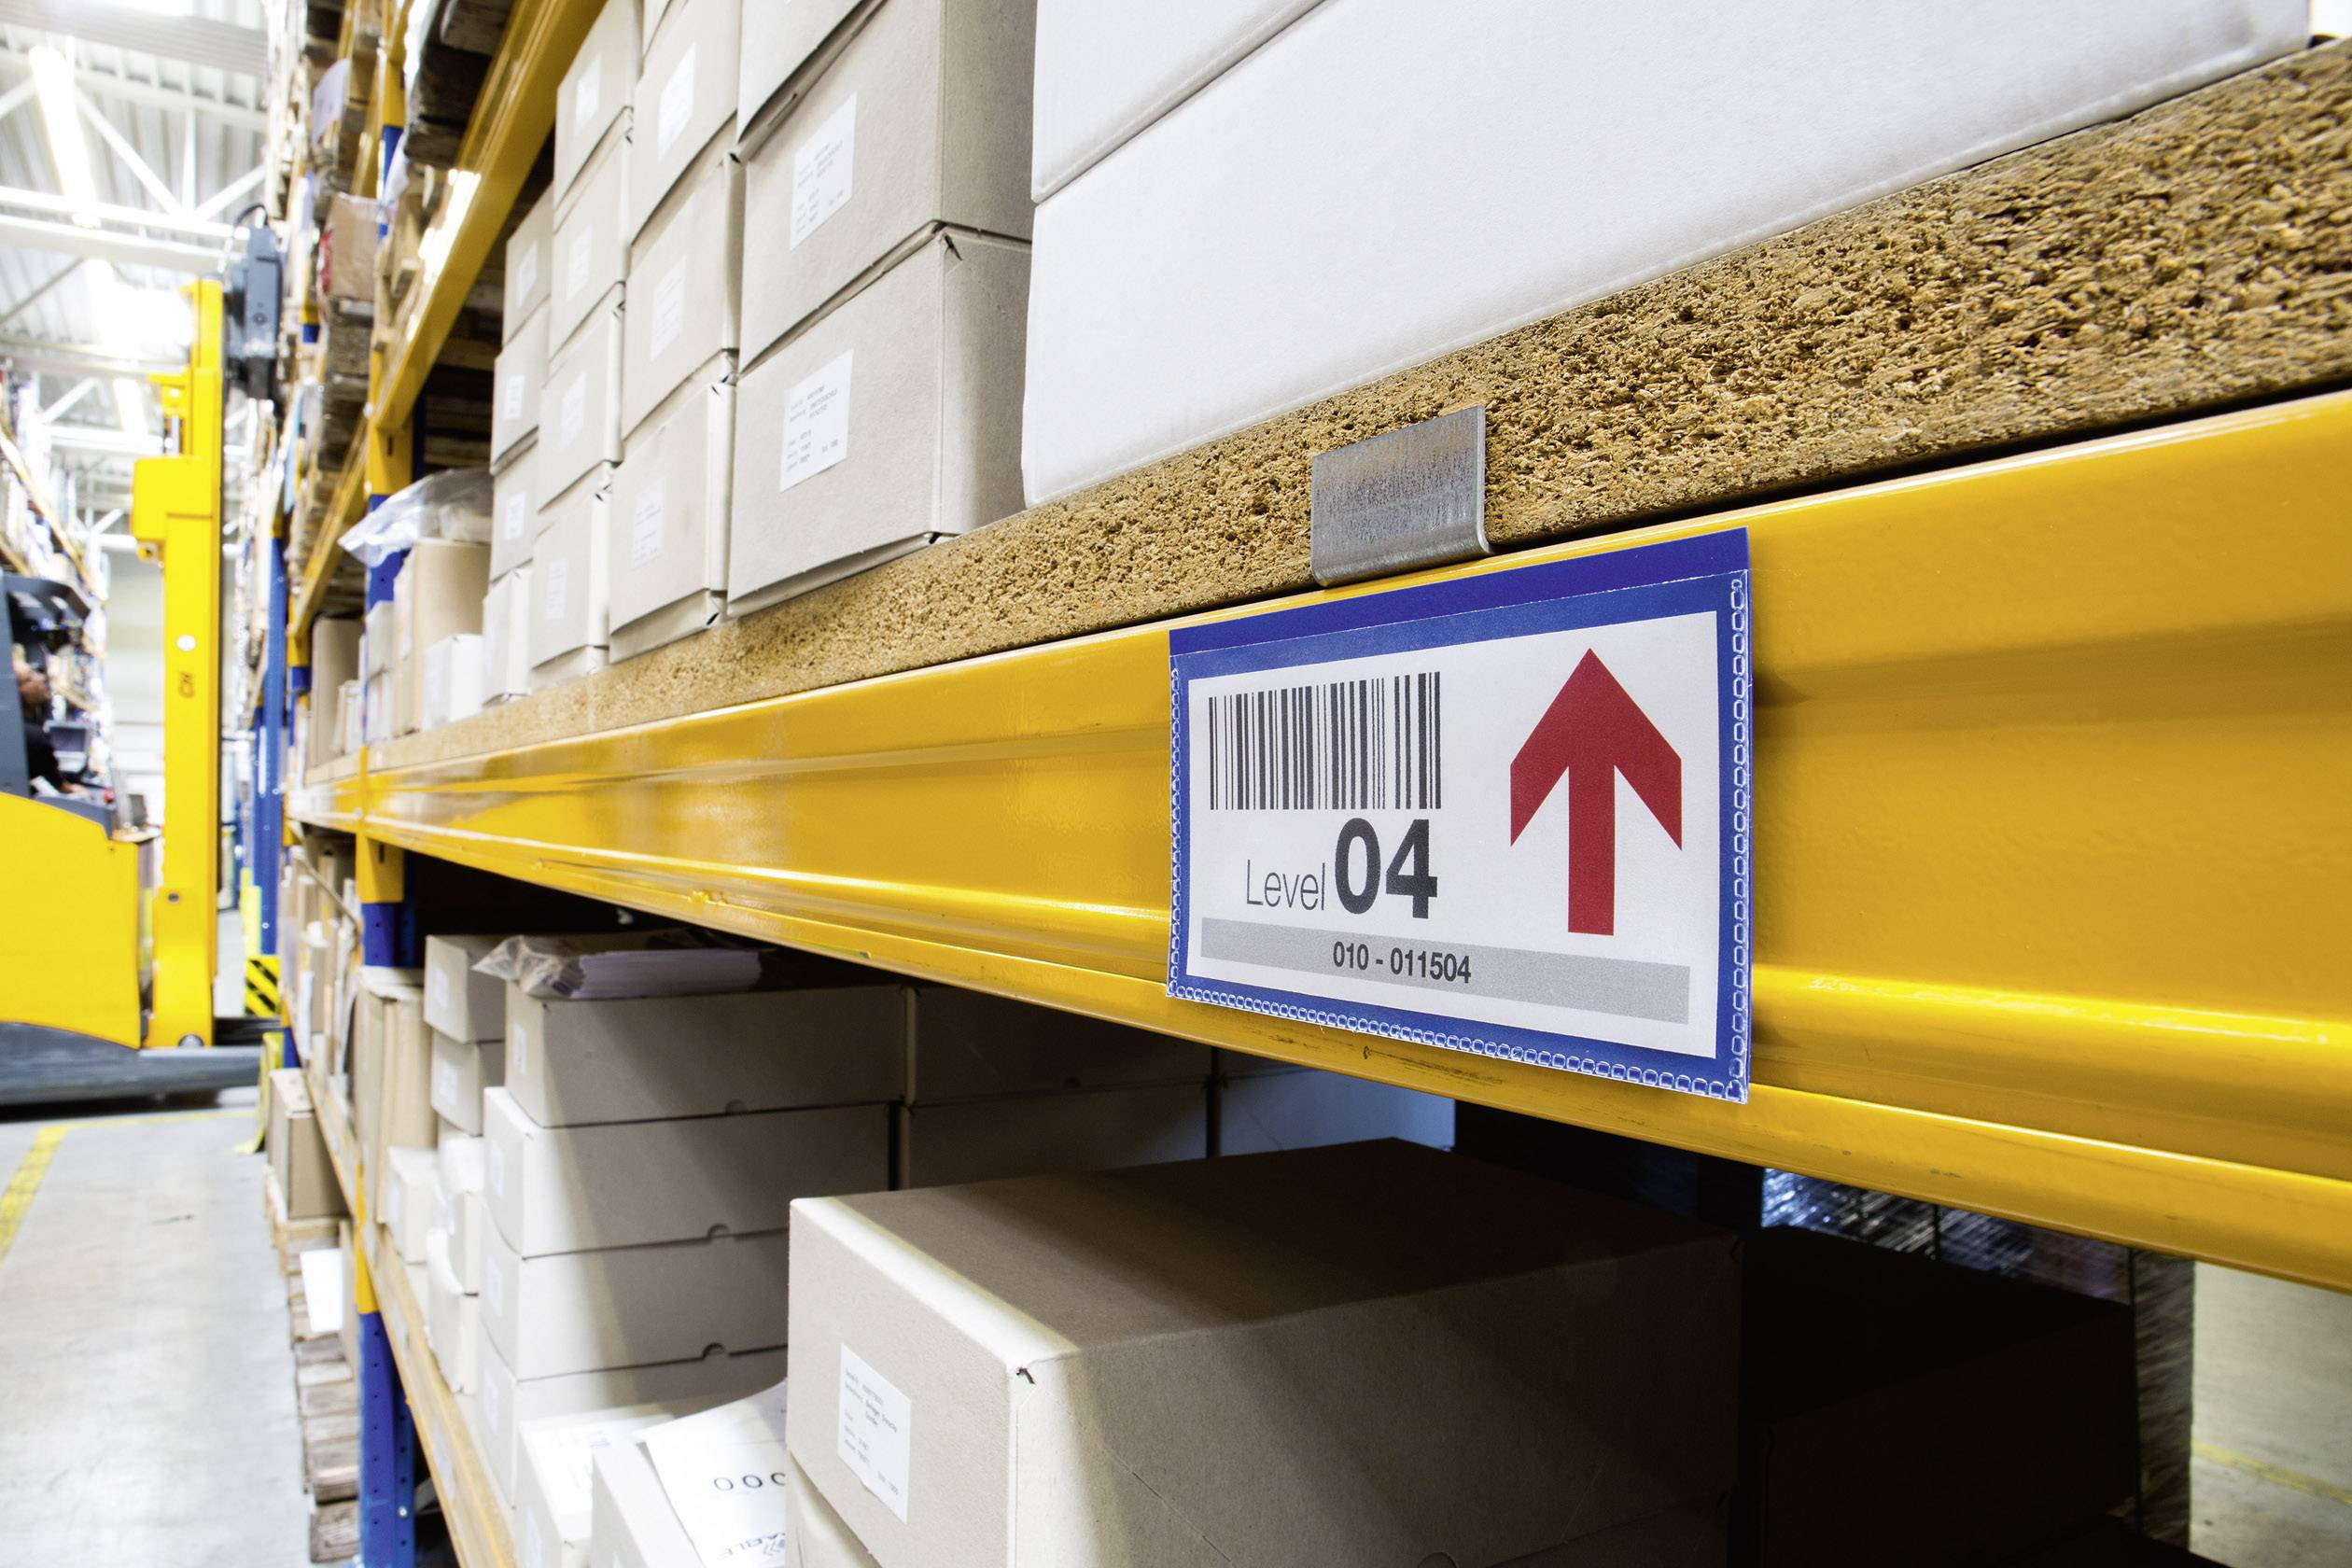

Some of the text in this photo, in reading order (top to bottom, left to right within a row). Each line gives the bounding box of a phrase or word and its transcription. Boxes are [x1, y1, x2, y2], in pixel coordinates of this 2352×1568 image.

[1246, 818, 1438, 919] Level 04
[1333, 941, 1369, 971] 010
[1391, 947, 1472, 984] 011504
